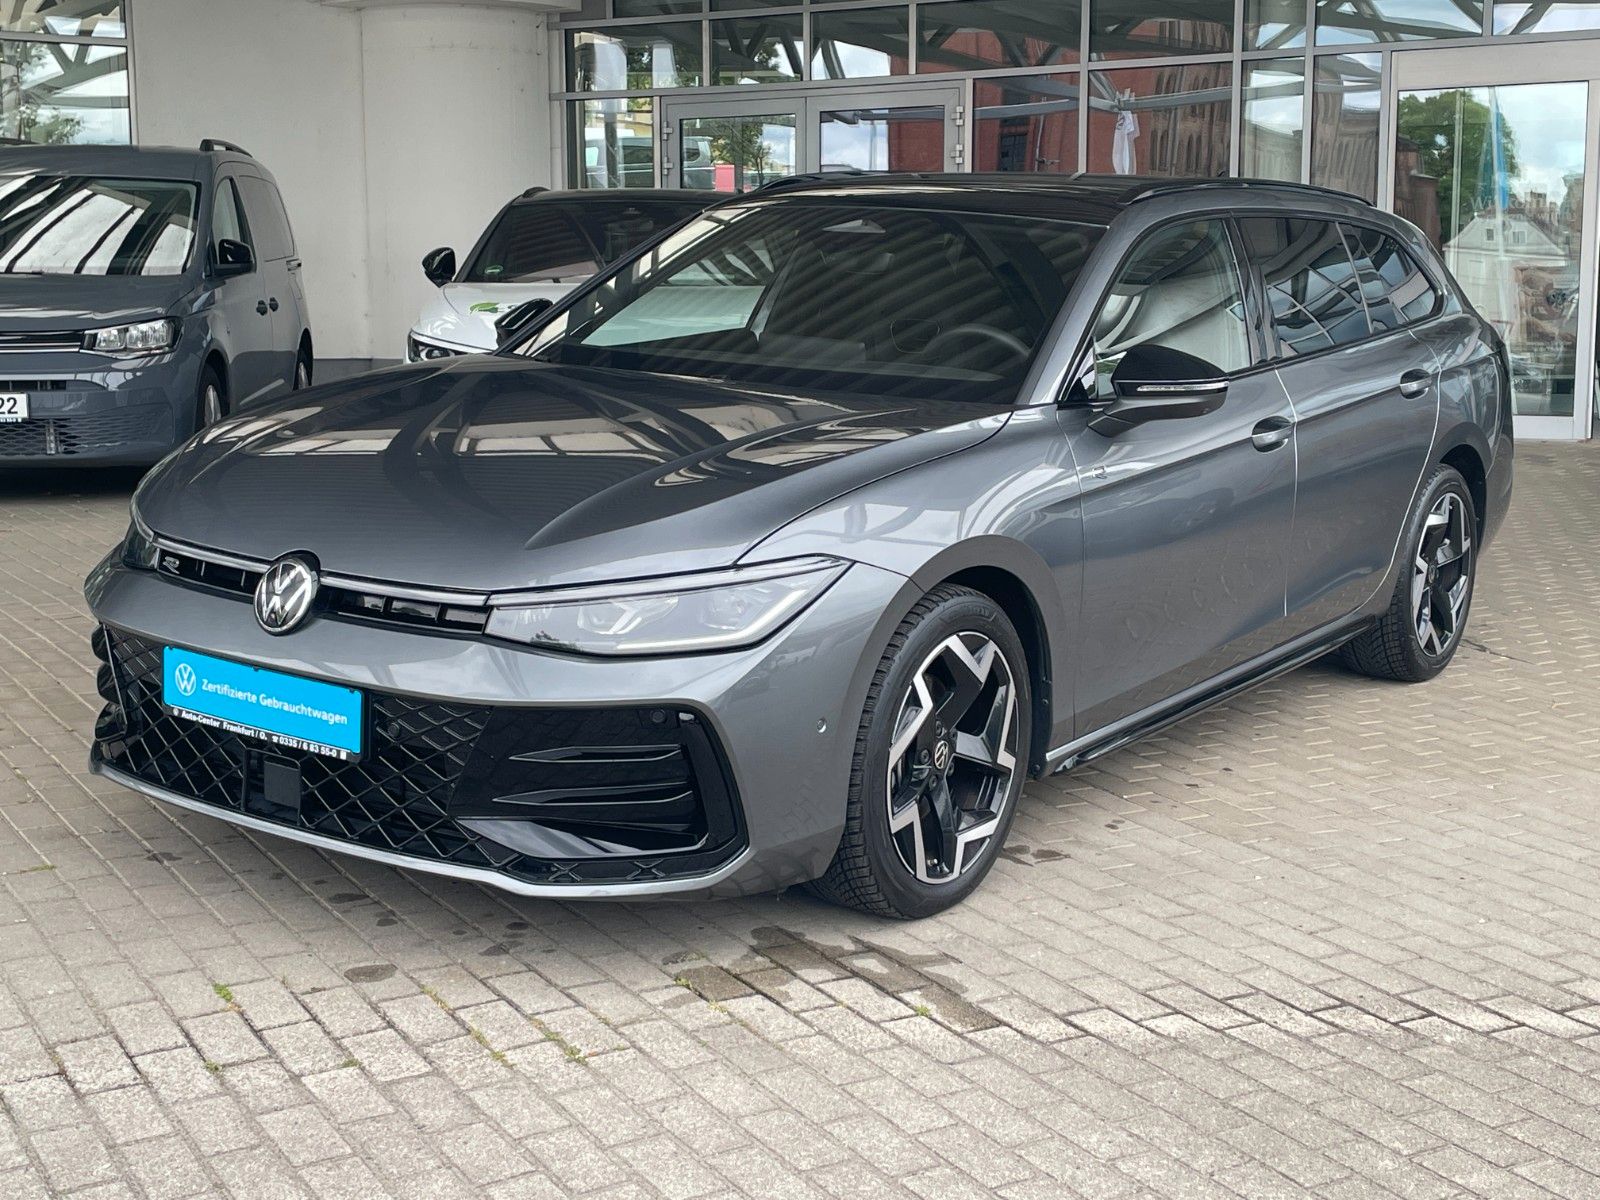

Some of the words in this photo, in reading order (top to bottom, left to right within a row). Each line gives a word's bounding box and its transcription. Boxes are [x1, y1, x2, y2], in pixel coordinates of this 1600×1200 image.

[202, 679, 257, 703] Zertifizierte
[259, 693, 348, 725] Gebrauchtwagen
[181, 710, 220, 728] Auto-Center
[223, 721, 254, 737] Frankfurt
[279, 736, 297, 748] 0335
